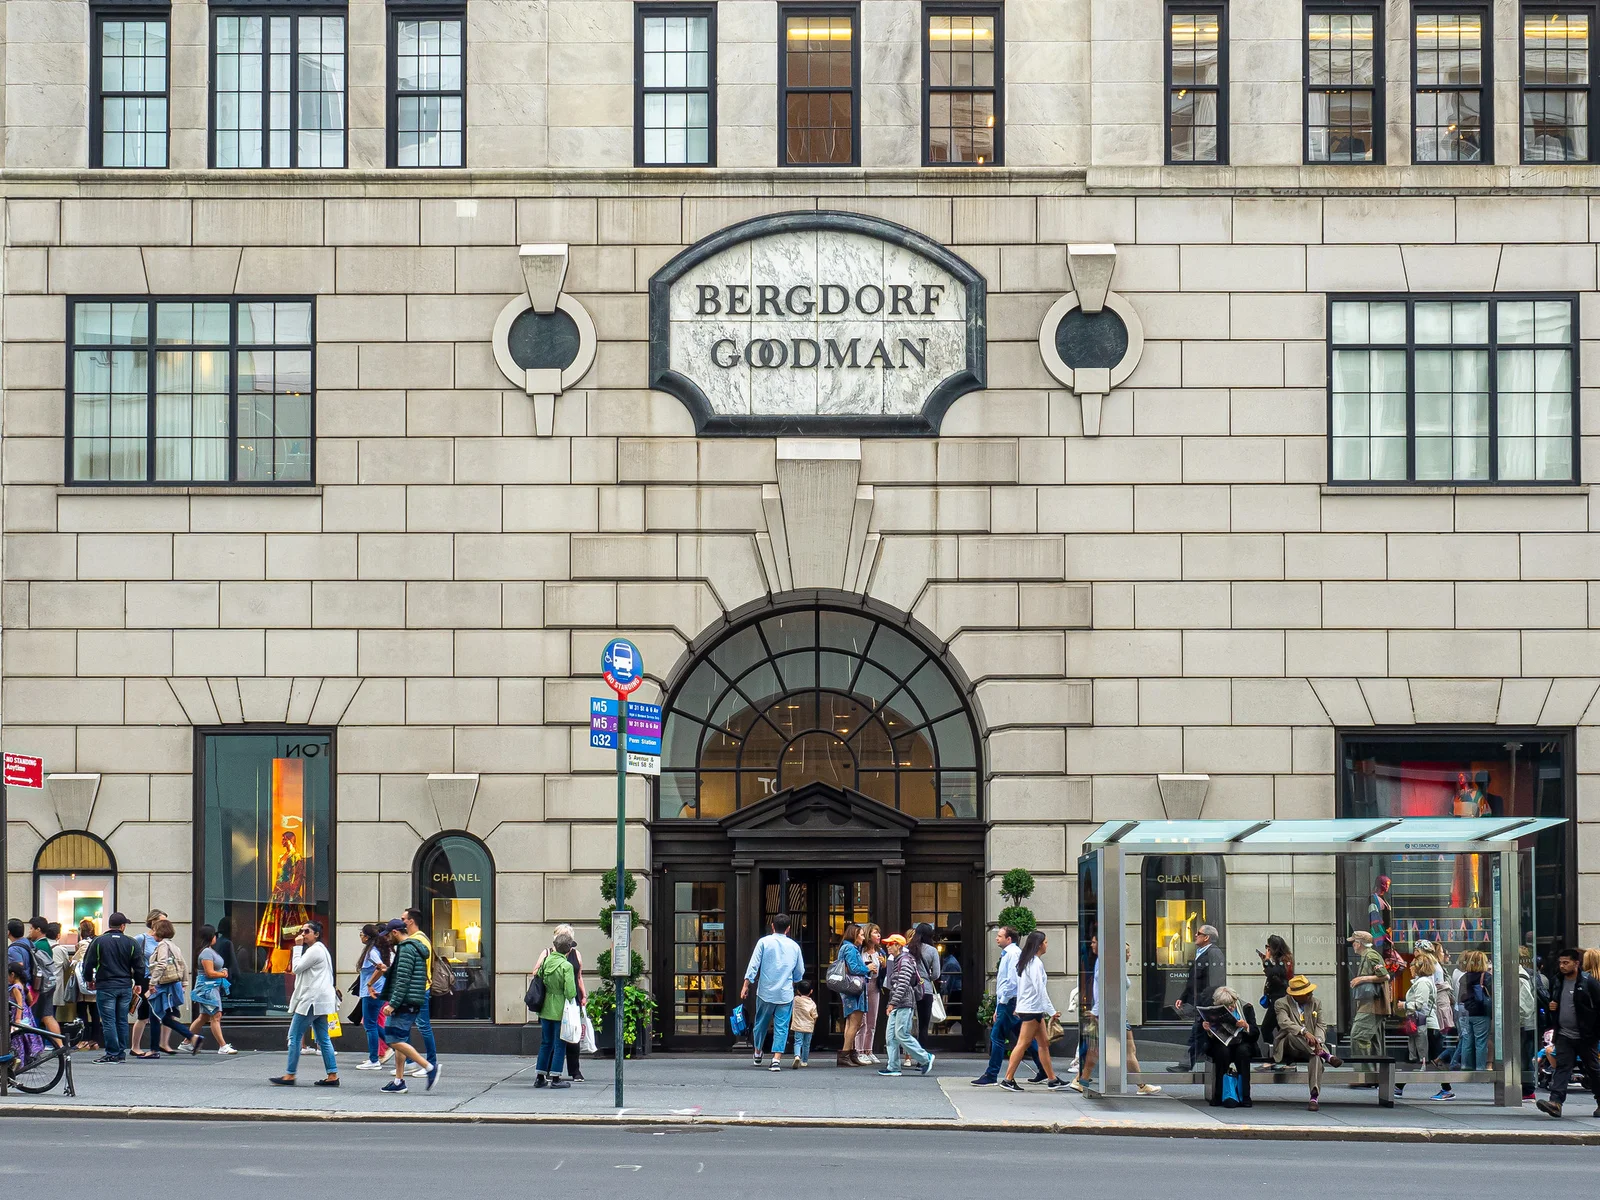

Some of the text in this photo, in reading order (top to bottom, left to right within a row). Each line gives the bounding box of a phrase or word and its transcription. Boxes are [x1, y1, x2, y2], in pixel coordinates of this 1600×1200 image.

[696, 284, 945, 316] BERGDORF
[710, 338, 930, 370] GOODMAN
[606, 673, 640, 691] NO STANDING
[592, 700, 607, 712] M5
[593, 717, 608, 729] M5
[593, 734, 611, 746] Q32
[14, 758, 37, 766] STANDING
[433, 873, 480, 881] CHANEL
[1157, 875, 1204, 883] CHANEL
